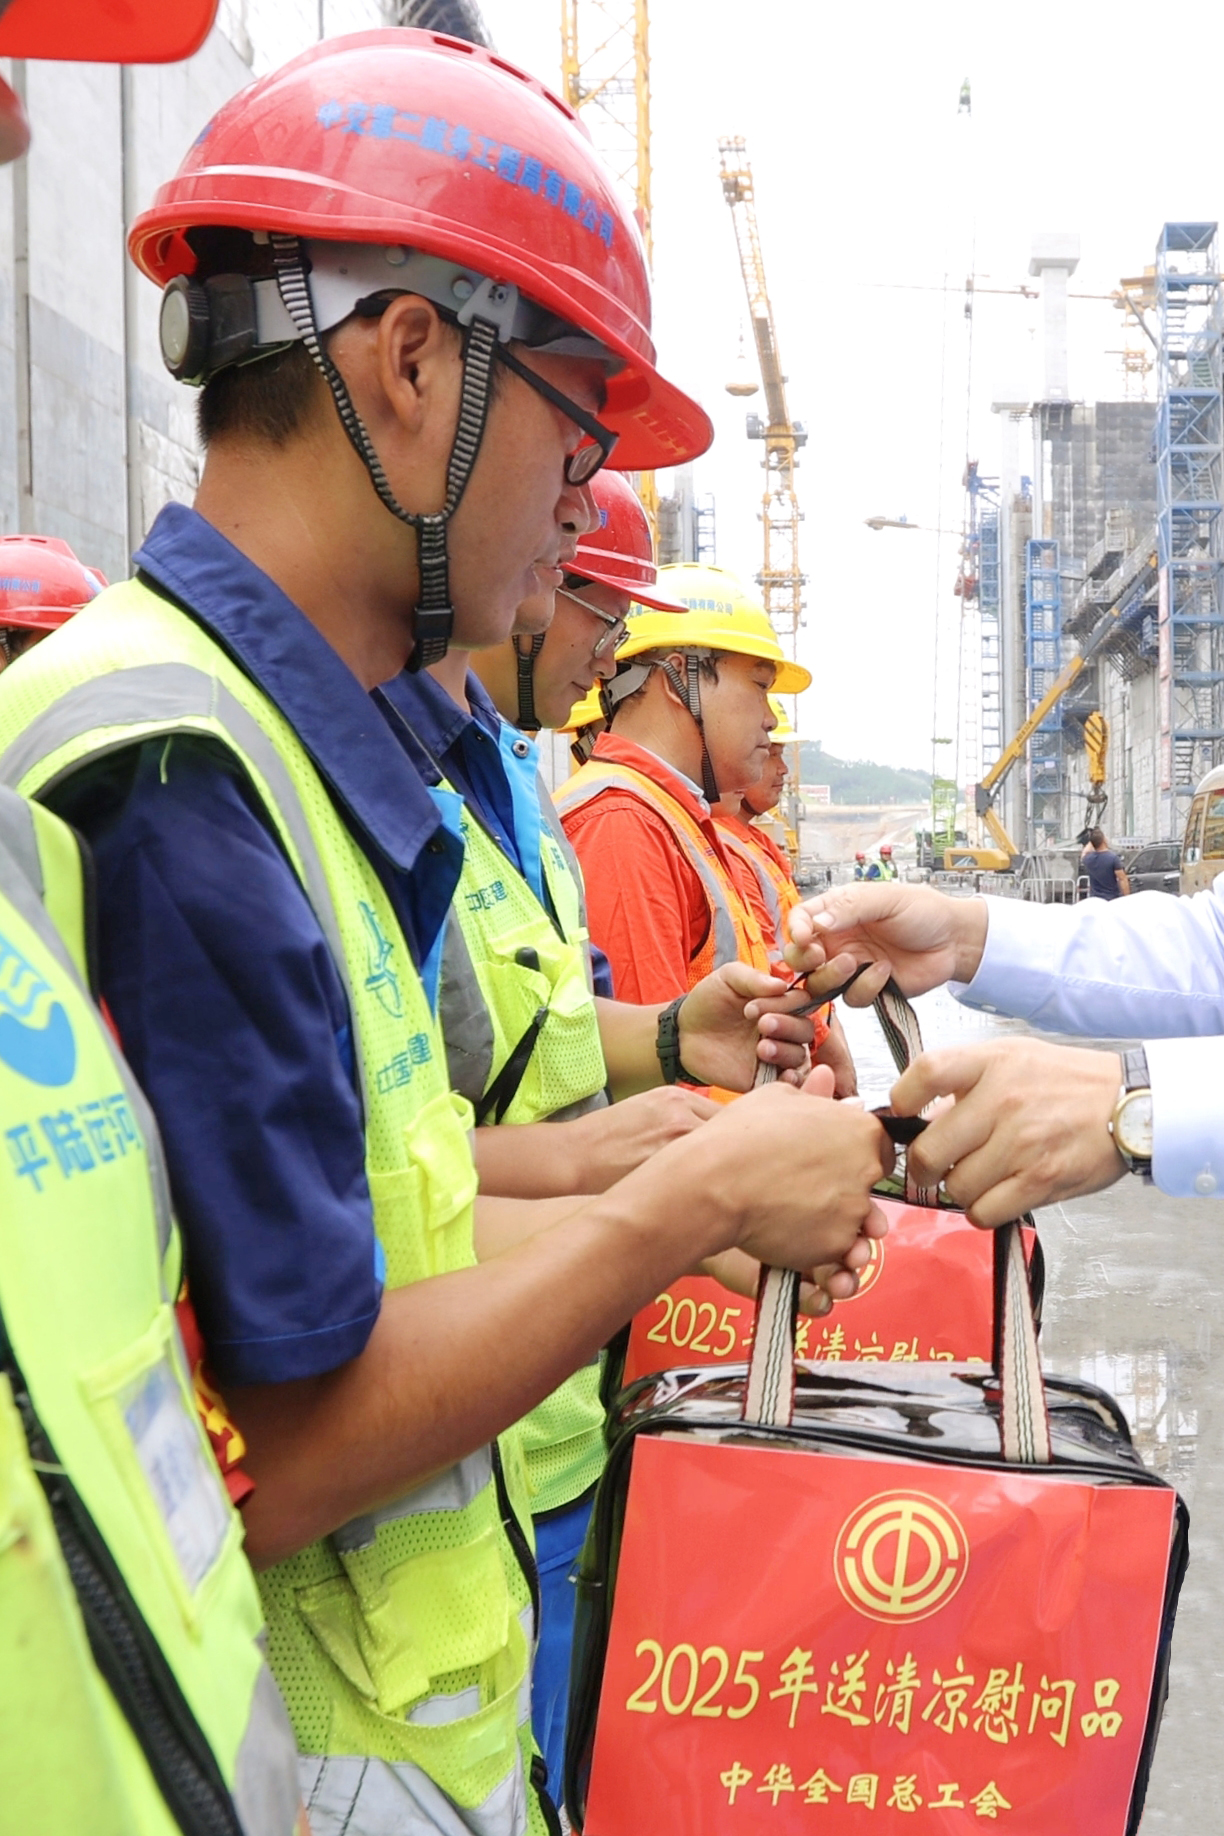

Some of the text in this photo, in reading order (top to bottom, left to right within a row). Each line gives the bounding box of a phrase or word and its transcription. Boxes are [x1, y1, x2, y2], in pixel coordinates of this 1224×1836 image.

[317, 100, 614, 247] 中交第二航务工程局有限公司
[5, 1093, 143, 1193] 平陆运河
[626, 1639, 1123, 1747] 2025年送清凉慰问品
[720, 1761, 1012, 1819] 中华全国总工会
